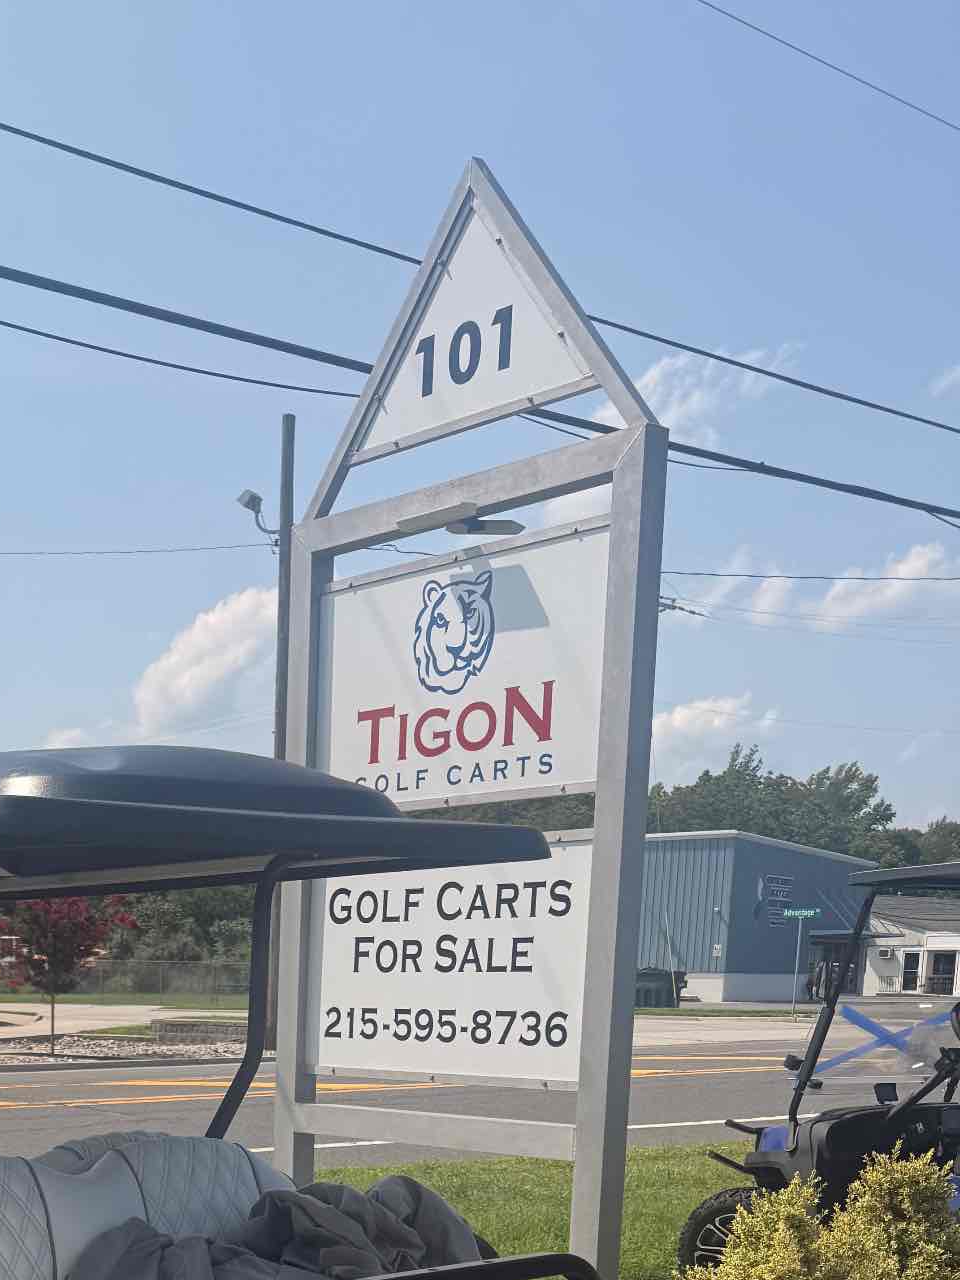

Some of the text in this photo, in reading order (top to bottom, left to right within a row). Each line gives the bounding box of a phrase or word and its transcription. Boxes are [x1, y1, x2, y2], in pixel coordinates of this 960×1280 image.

[415, 304, 513, 398] 101
[356, 680, 555, 765] TIGON
[446, 753, 553, 785] CARTS
[328, 879, 573, 925] GOLF CARTS
[352, 934, 535, 973] FOR SALE
[324, 1006, 569, 1048] 215-595-8736
